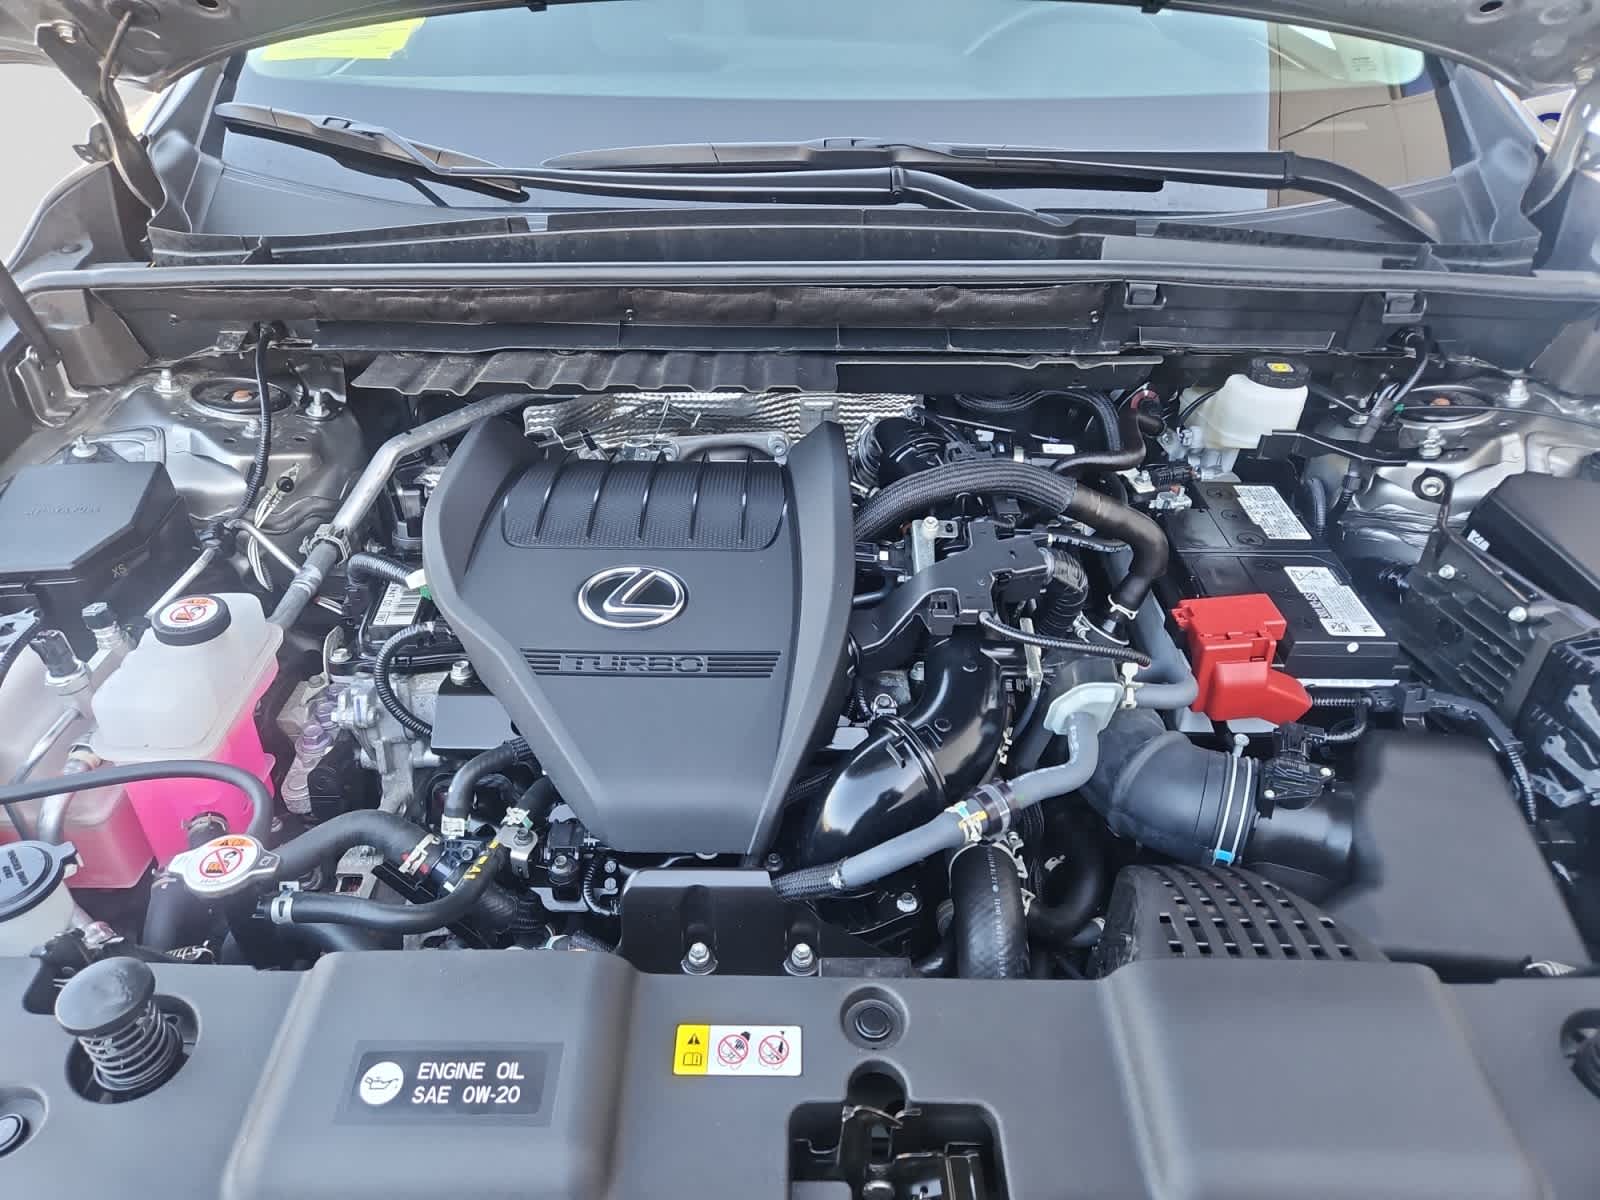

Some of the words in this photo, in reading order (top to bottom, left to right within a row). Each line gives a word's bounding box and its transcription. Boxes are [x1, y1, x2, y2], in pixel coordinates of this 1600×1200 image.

[560, 654, 705, 674] TURBO
[416, 1061, 486, 1080] ENGINE
[495, 1061, 525, 1080] OIL
[411, 1085, 452, 1105] SAE
[461, 1085, 522, 1105] 0W-20
